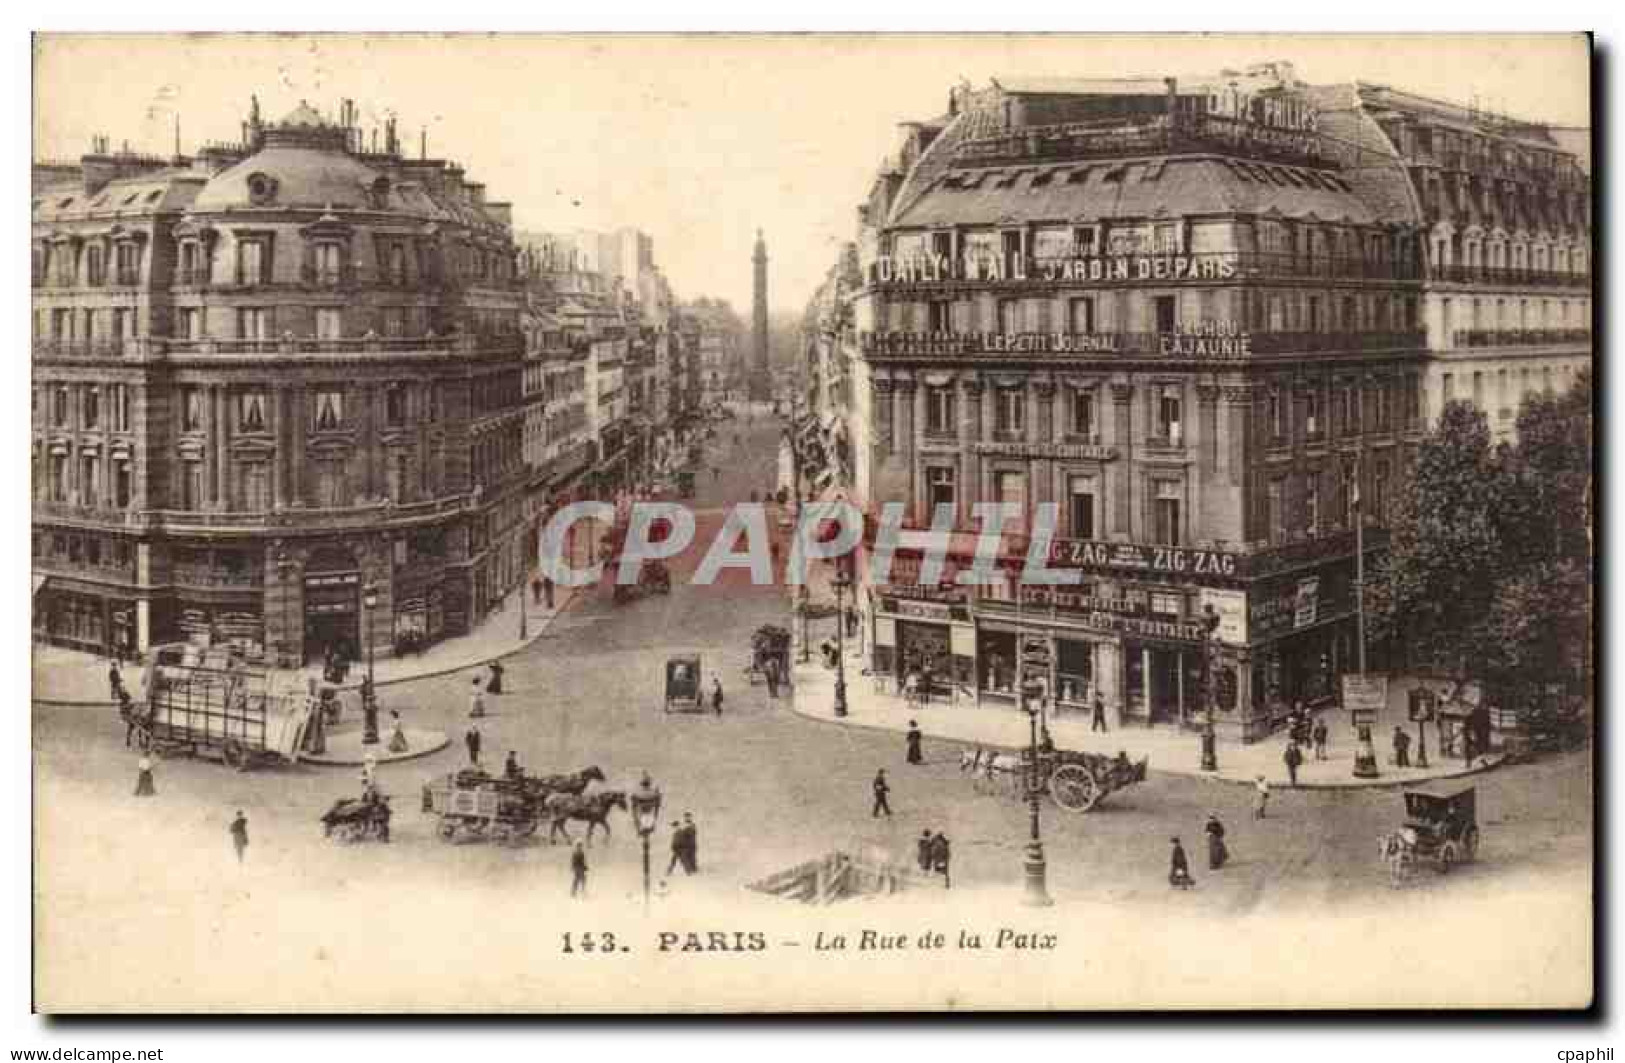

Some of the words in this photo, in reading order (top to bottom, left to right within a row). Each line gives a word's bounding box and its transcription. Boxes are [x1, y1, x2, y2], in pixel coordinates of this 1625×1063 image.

[880, 250, 943, 282] DAILY
[963, 250, 1026, 281] MAIL
[1044, 257, 1129, 281] JARDIN
[1138, 258, 1167, 279] DE
[1174, 254, 1236, 279] PARIS
